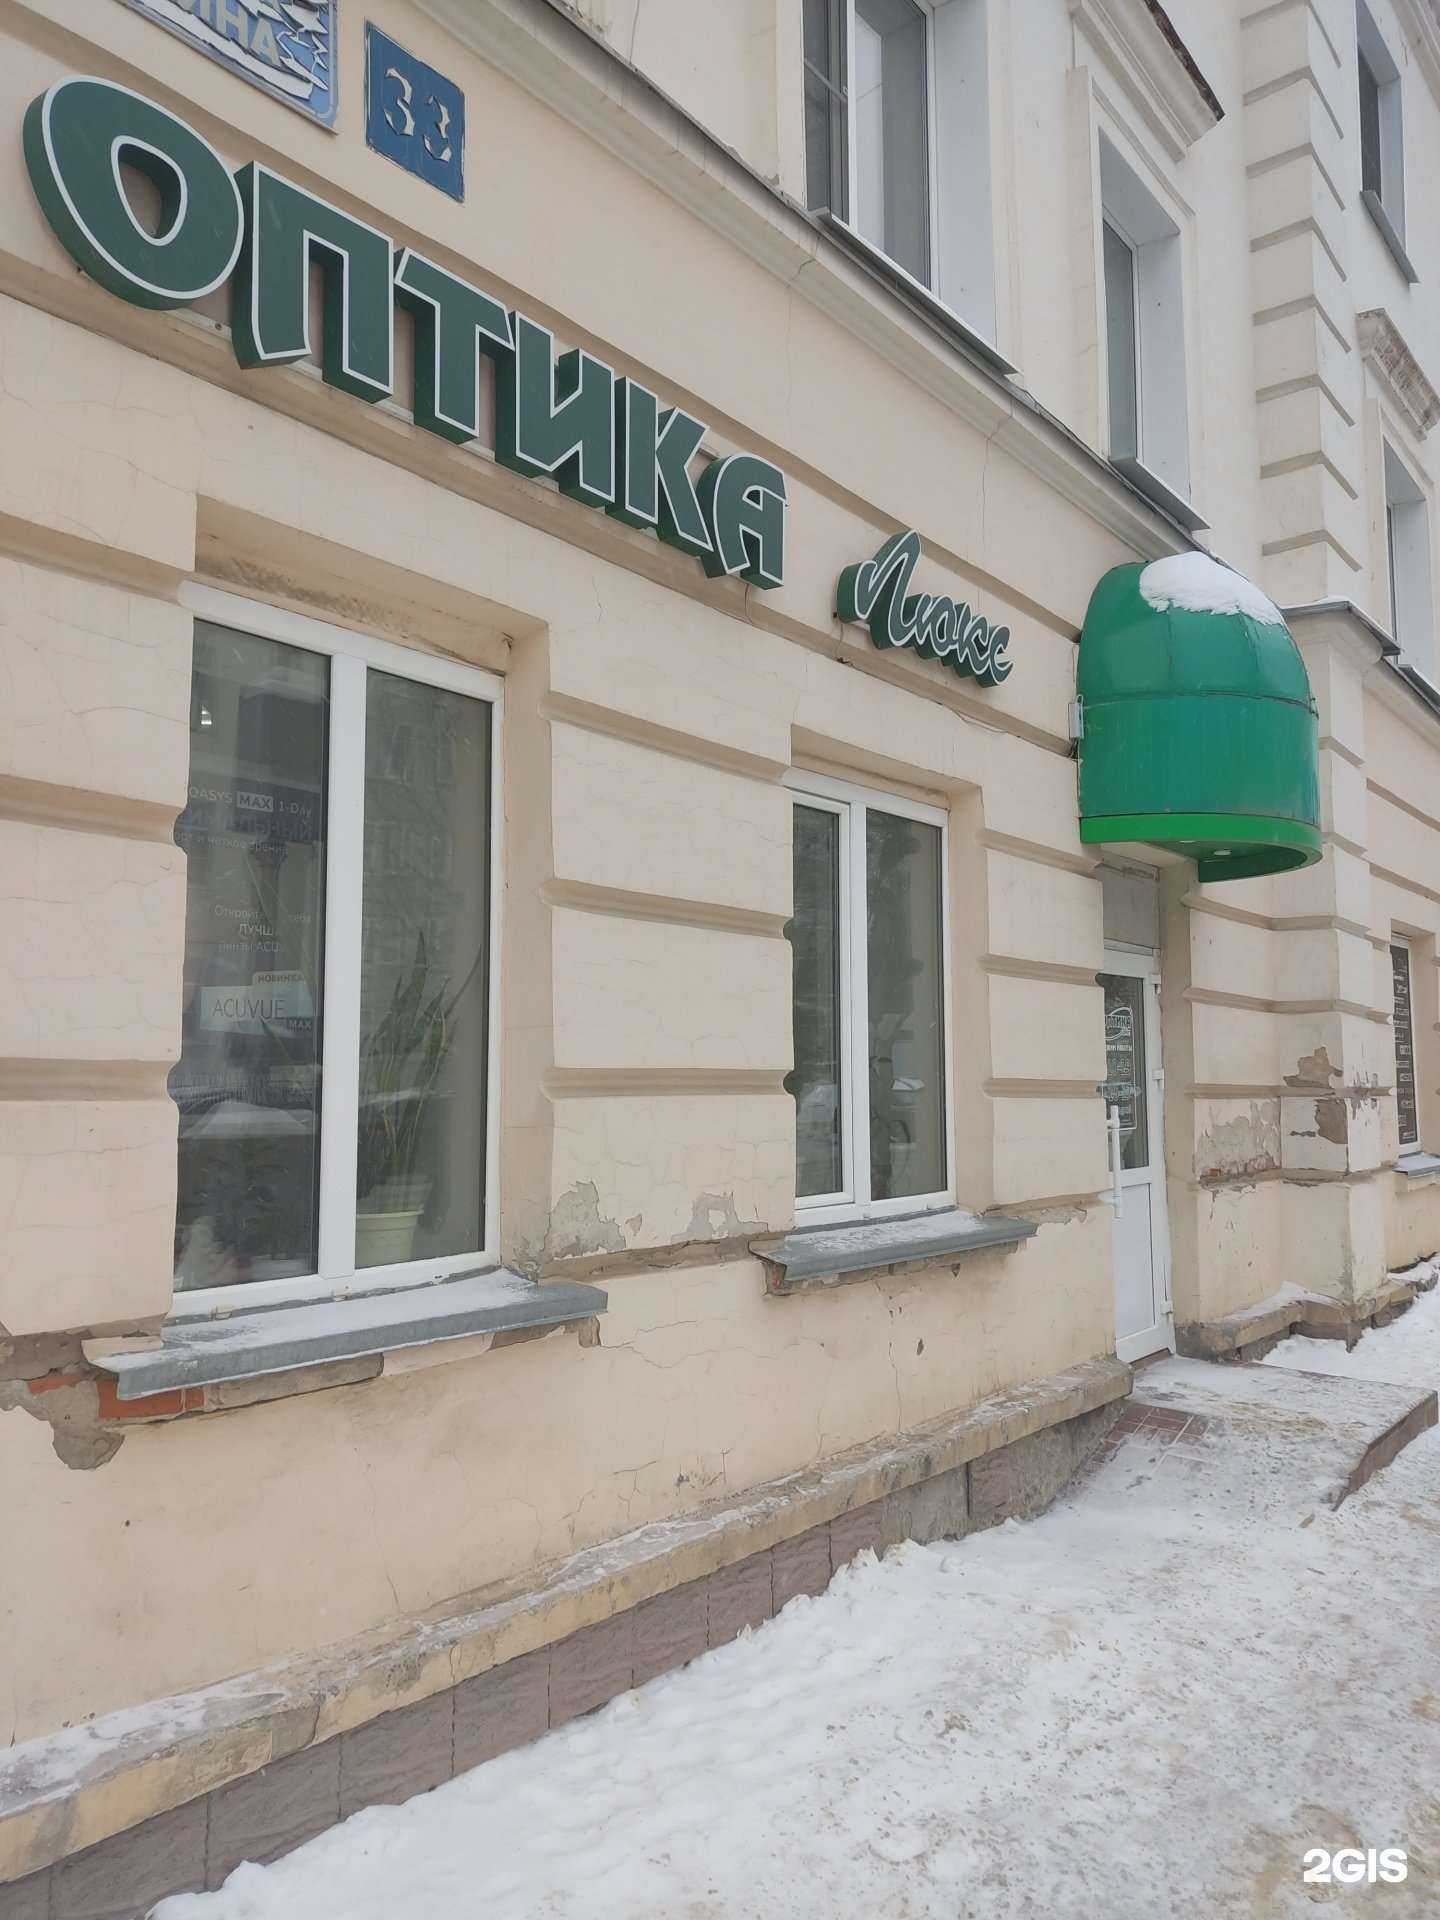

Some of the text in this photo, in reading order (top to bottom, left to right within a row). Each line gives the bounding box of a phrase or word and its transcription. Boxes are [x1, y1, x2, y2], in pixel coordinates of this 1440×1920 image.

[384, 67, 452, 163] 33
[25, 75, 1014, 687] ОПТИКА Люкс
[239, 795, 271, 810] MAX
[212, 998, 286, 1020] ACUVUE
